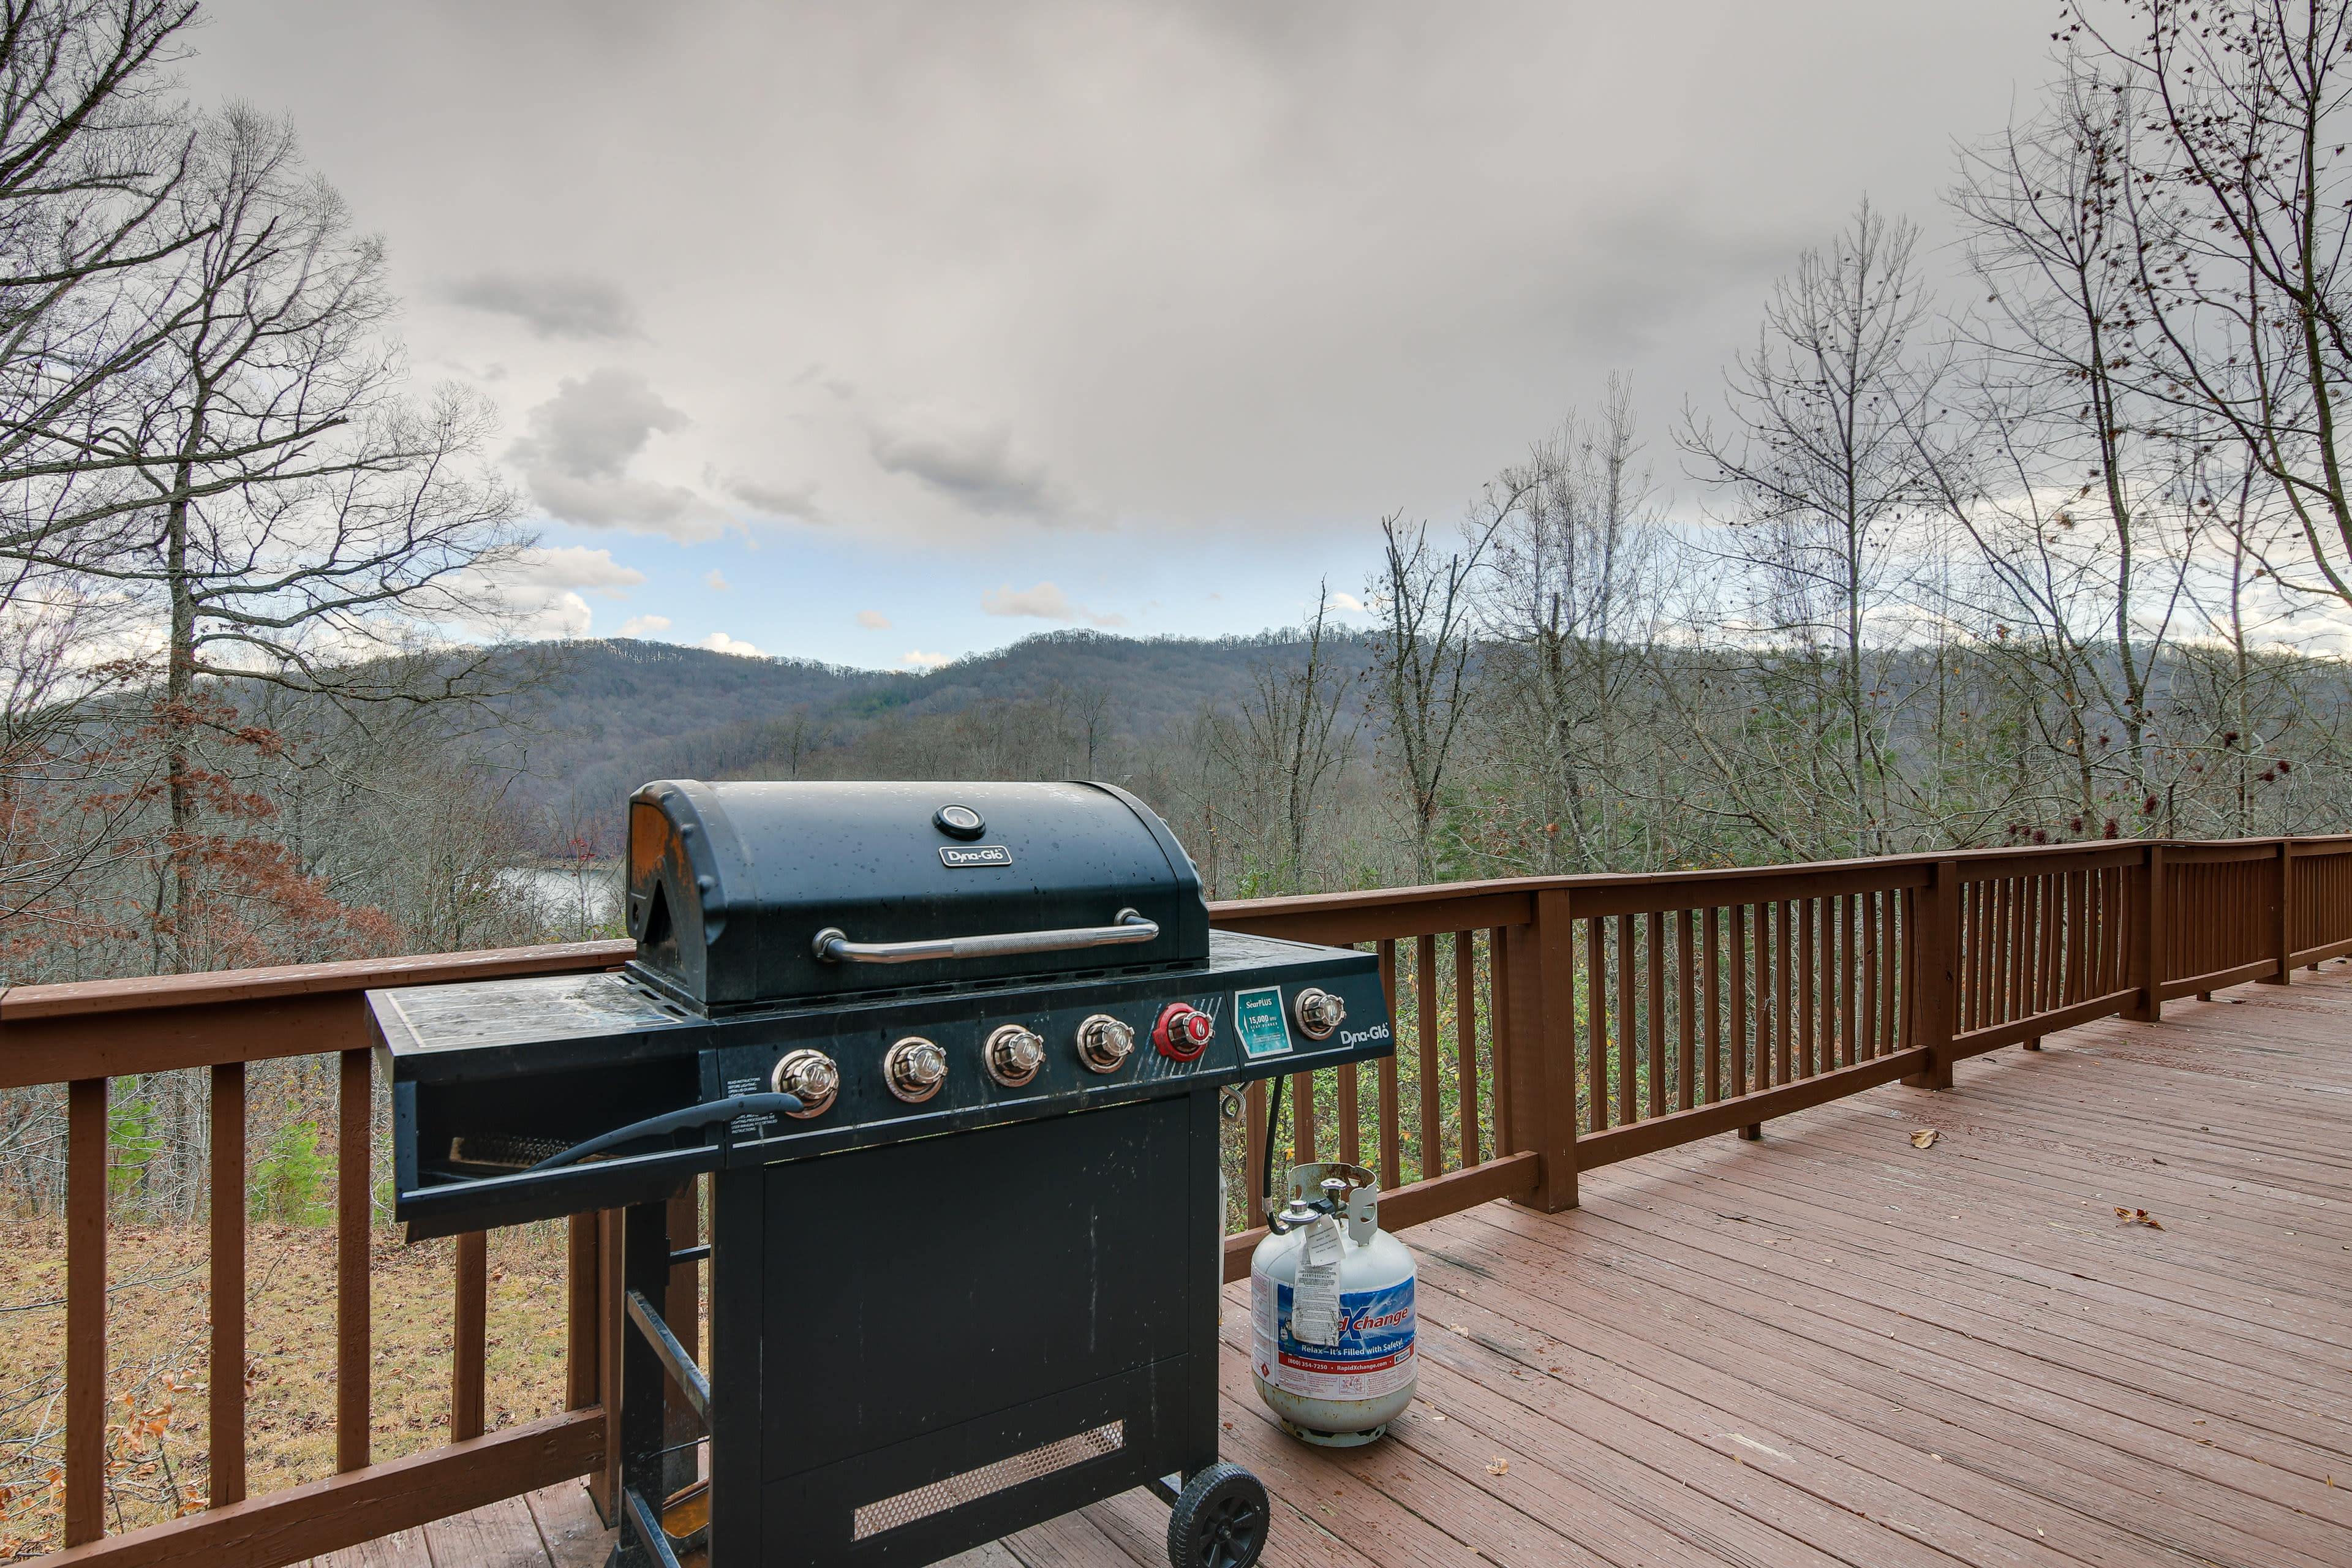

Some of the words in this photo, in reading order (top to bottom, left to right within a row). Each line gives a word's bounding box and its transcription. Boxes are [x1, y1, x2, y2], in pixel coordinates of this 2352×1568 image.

[948, 849, 1003, 862] Dyna-Glo
[1246, 998, 1272, 1009] SearPLUS
[1249, 1015, 1268, 1025] 15,000
[1340, 1023, 1389, 1049] Dyna-Glo
[1343, 1348, 1365, 1356] Filled
[1366, 1346, 1382, 1354] with
[1287, 1357, 1301, 1366] (800)
[1302, 1361, 1328, 1370] 354-7250
[1337, 1361, 1387, 1372] RapidXchange.com
